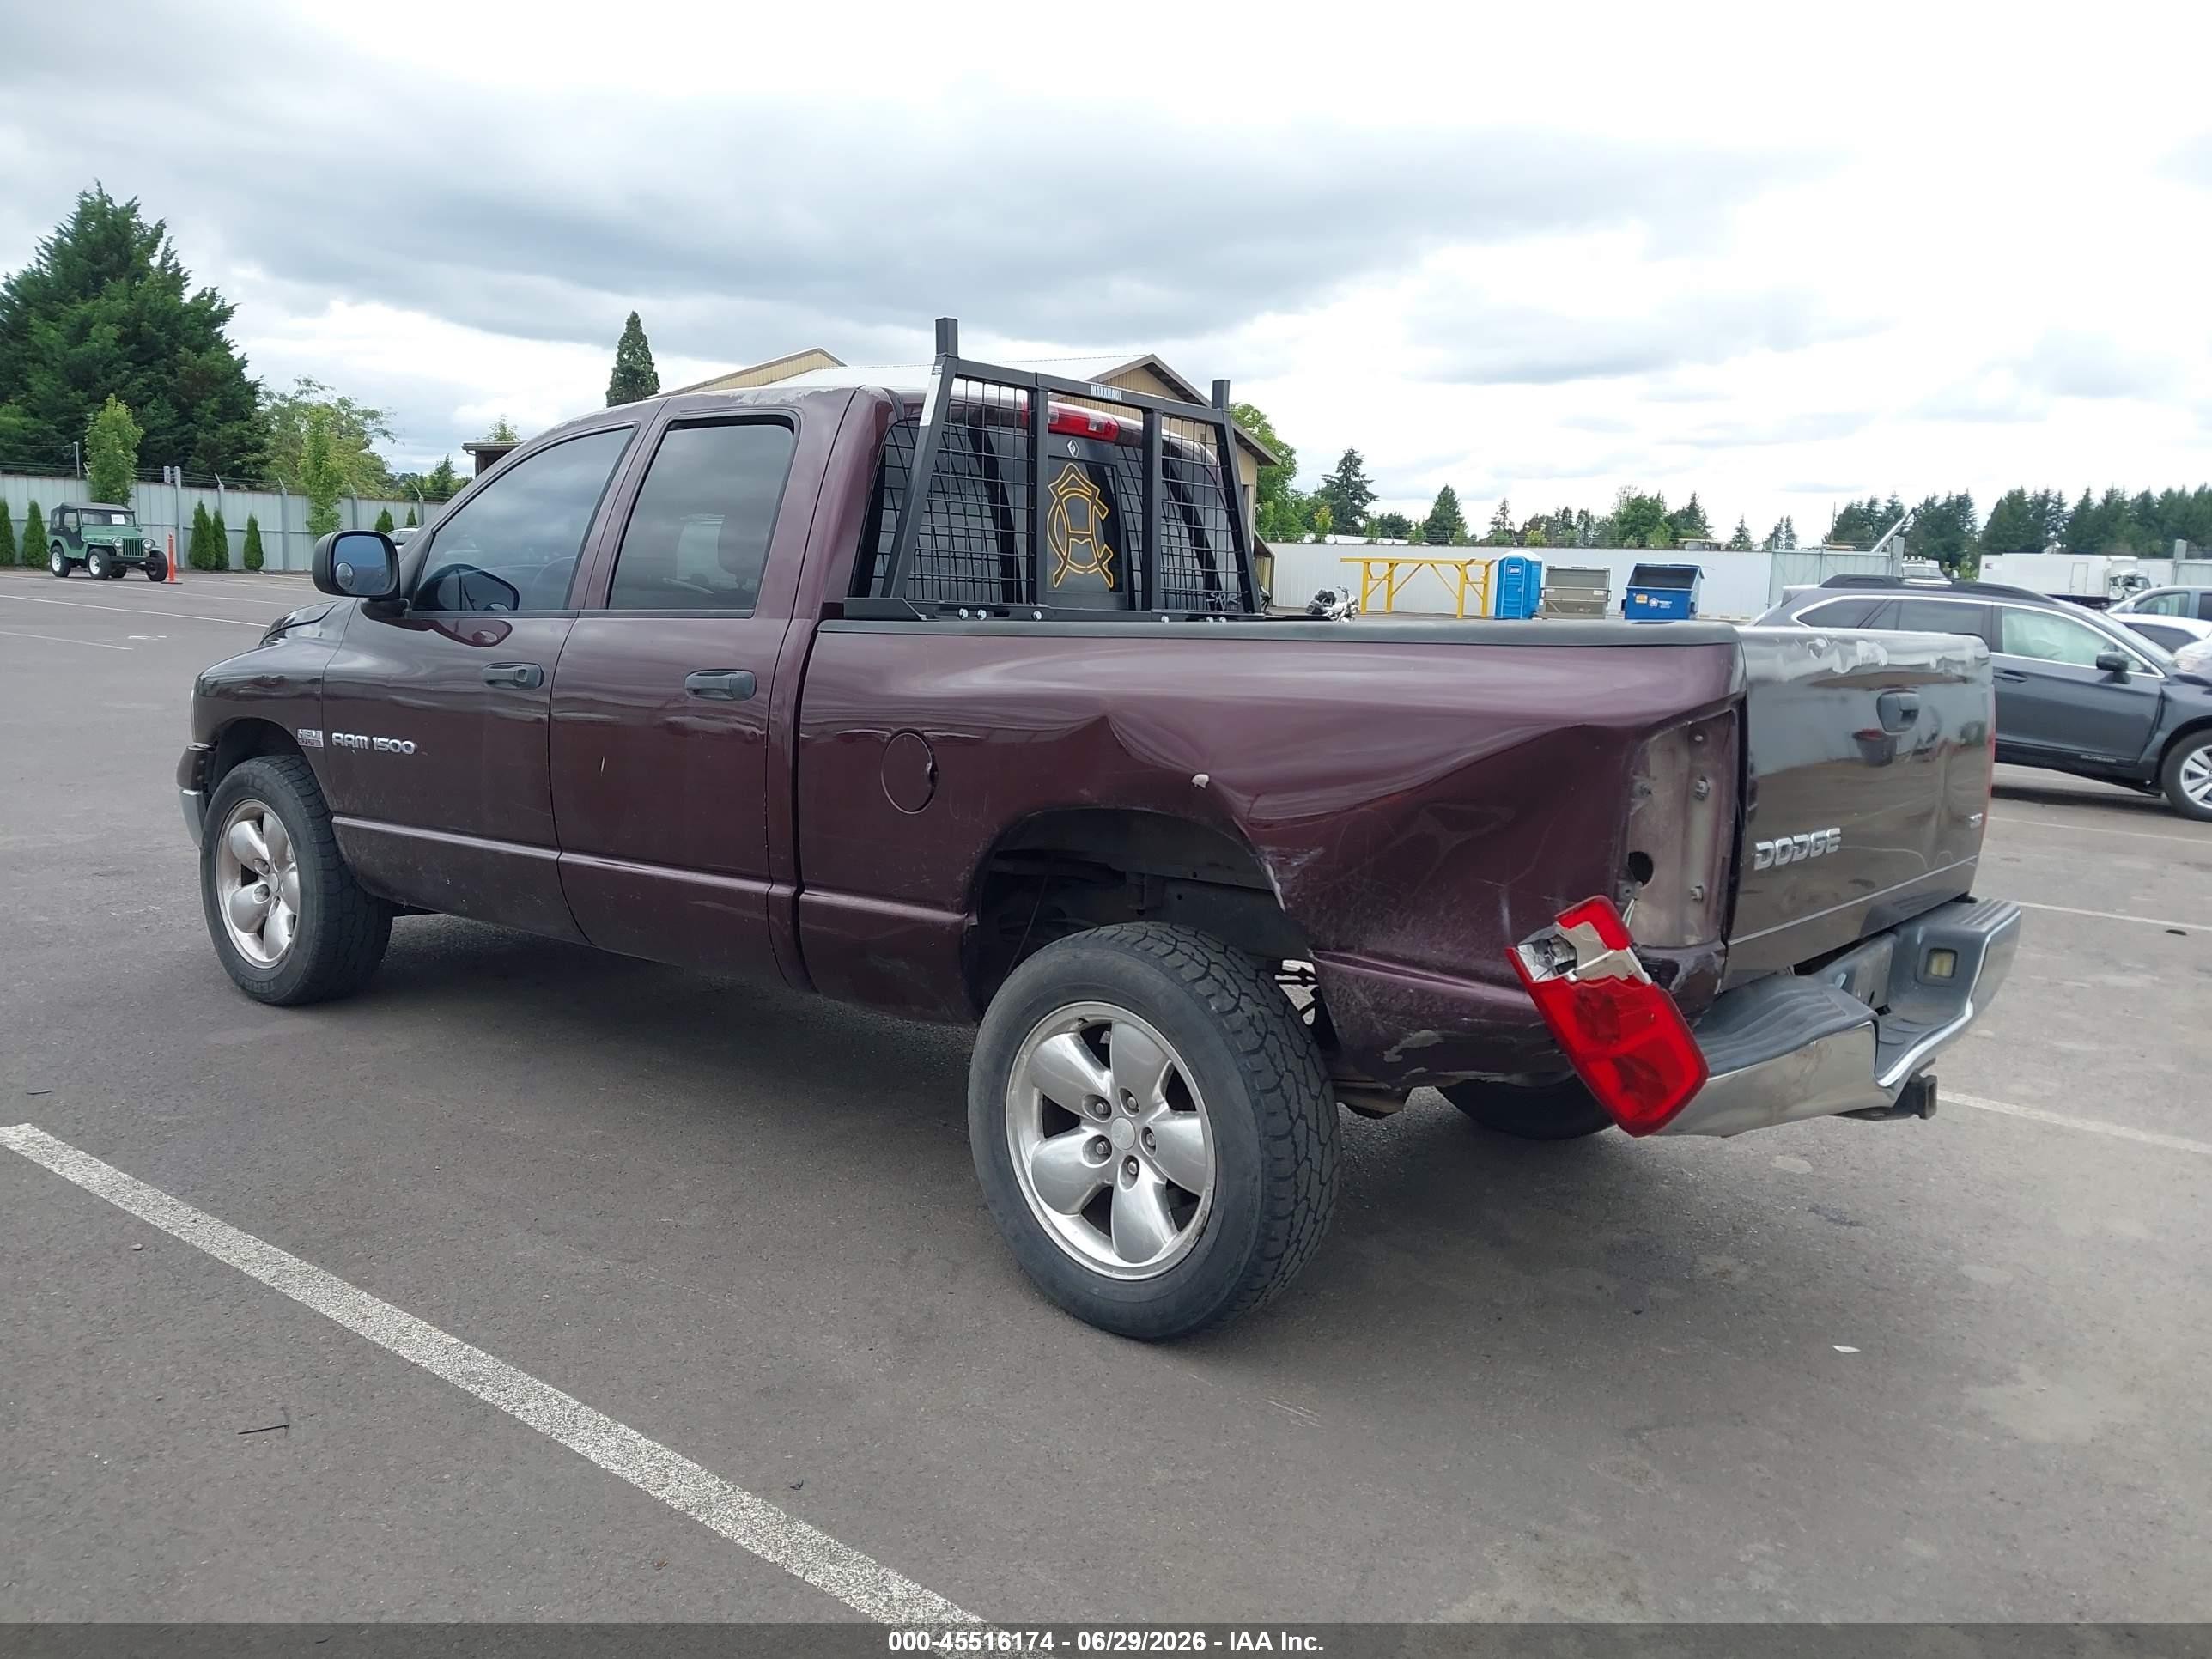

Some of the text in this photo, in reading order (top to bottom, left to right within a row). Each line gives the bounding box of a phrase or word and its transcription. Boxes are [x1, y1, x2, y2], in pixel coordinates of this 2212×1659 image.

[331, 732, 369, 749] RAM
[372, 737, 416, 755] 1500
[1753, 827, 1841, 871] DODGE
